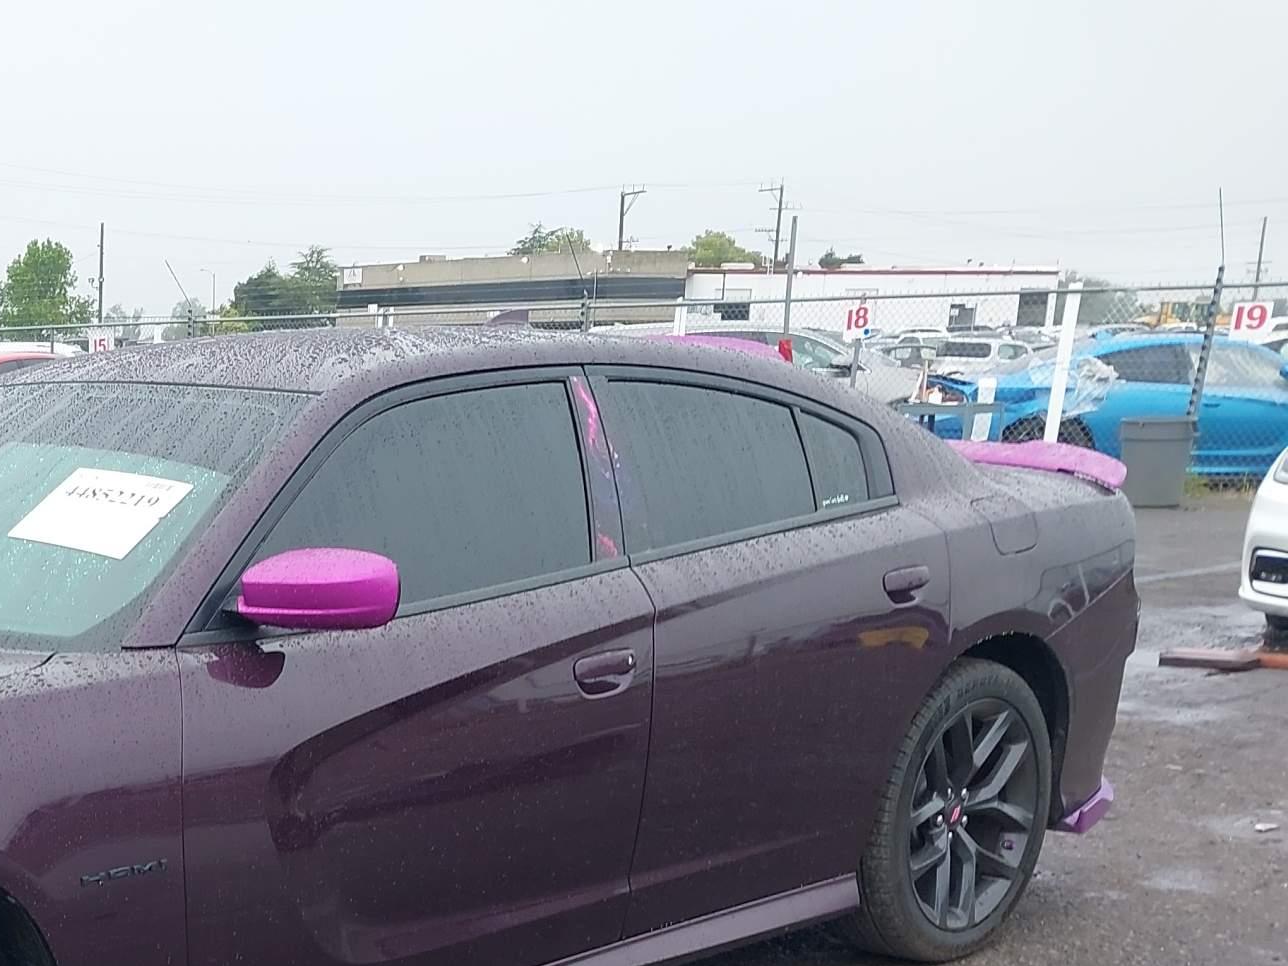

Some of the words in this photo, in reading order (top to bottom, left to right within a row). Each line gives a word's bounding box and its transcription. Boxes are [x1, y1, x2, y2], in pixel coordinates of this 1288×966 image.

[846, 306, 869, 331] 18
[1233, 304, 1268, 330] 19
[65, 485, 161, 507] 44852219
